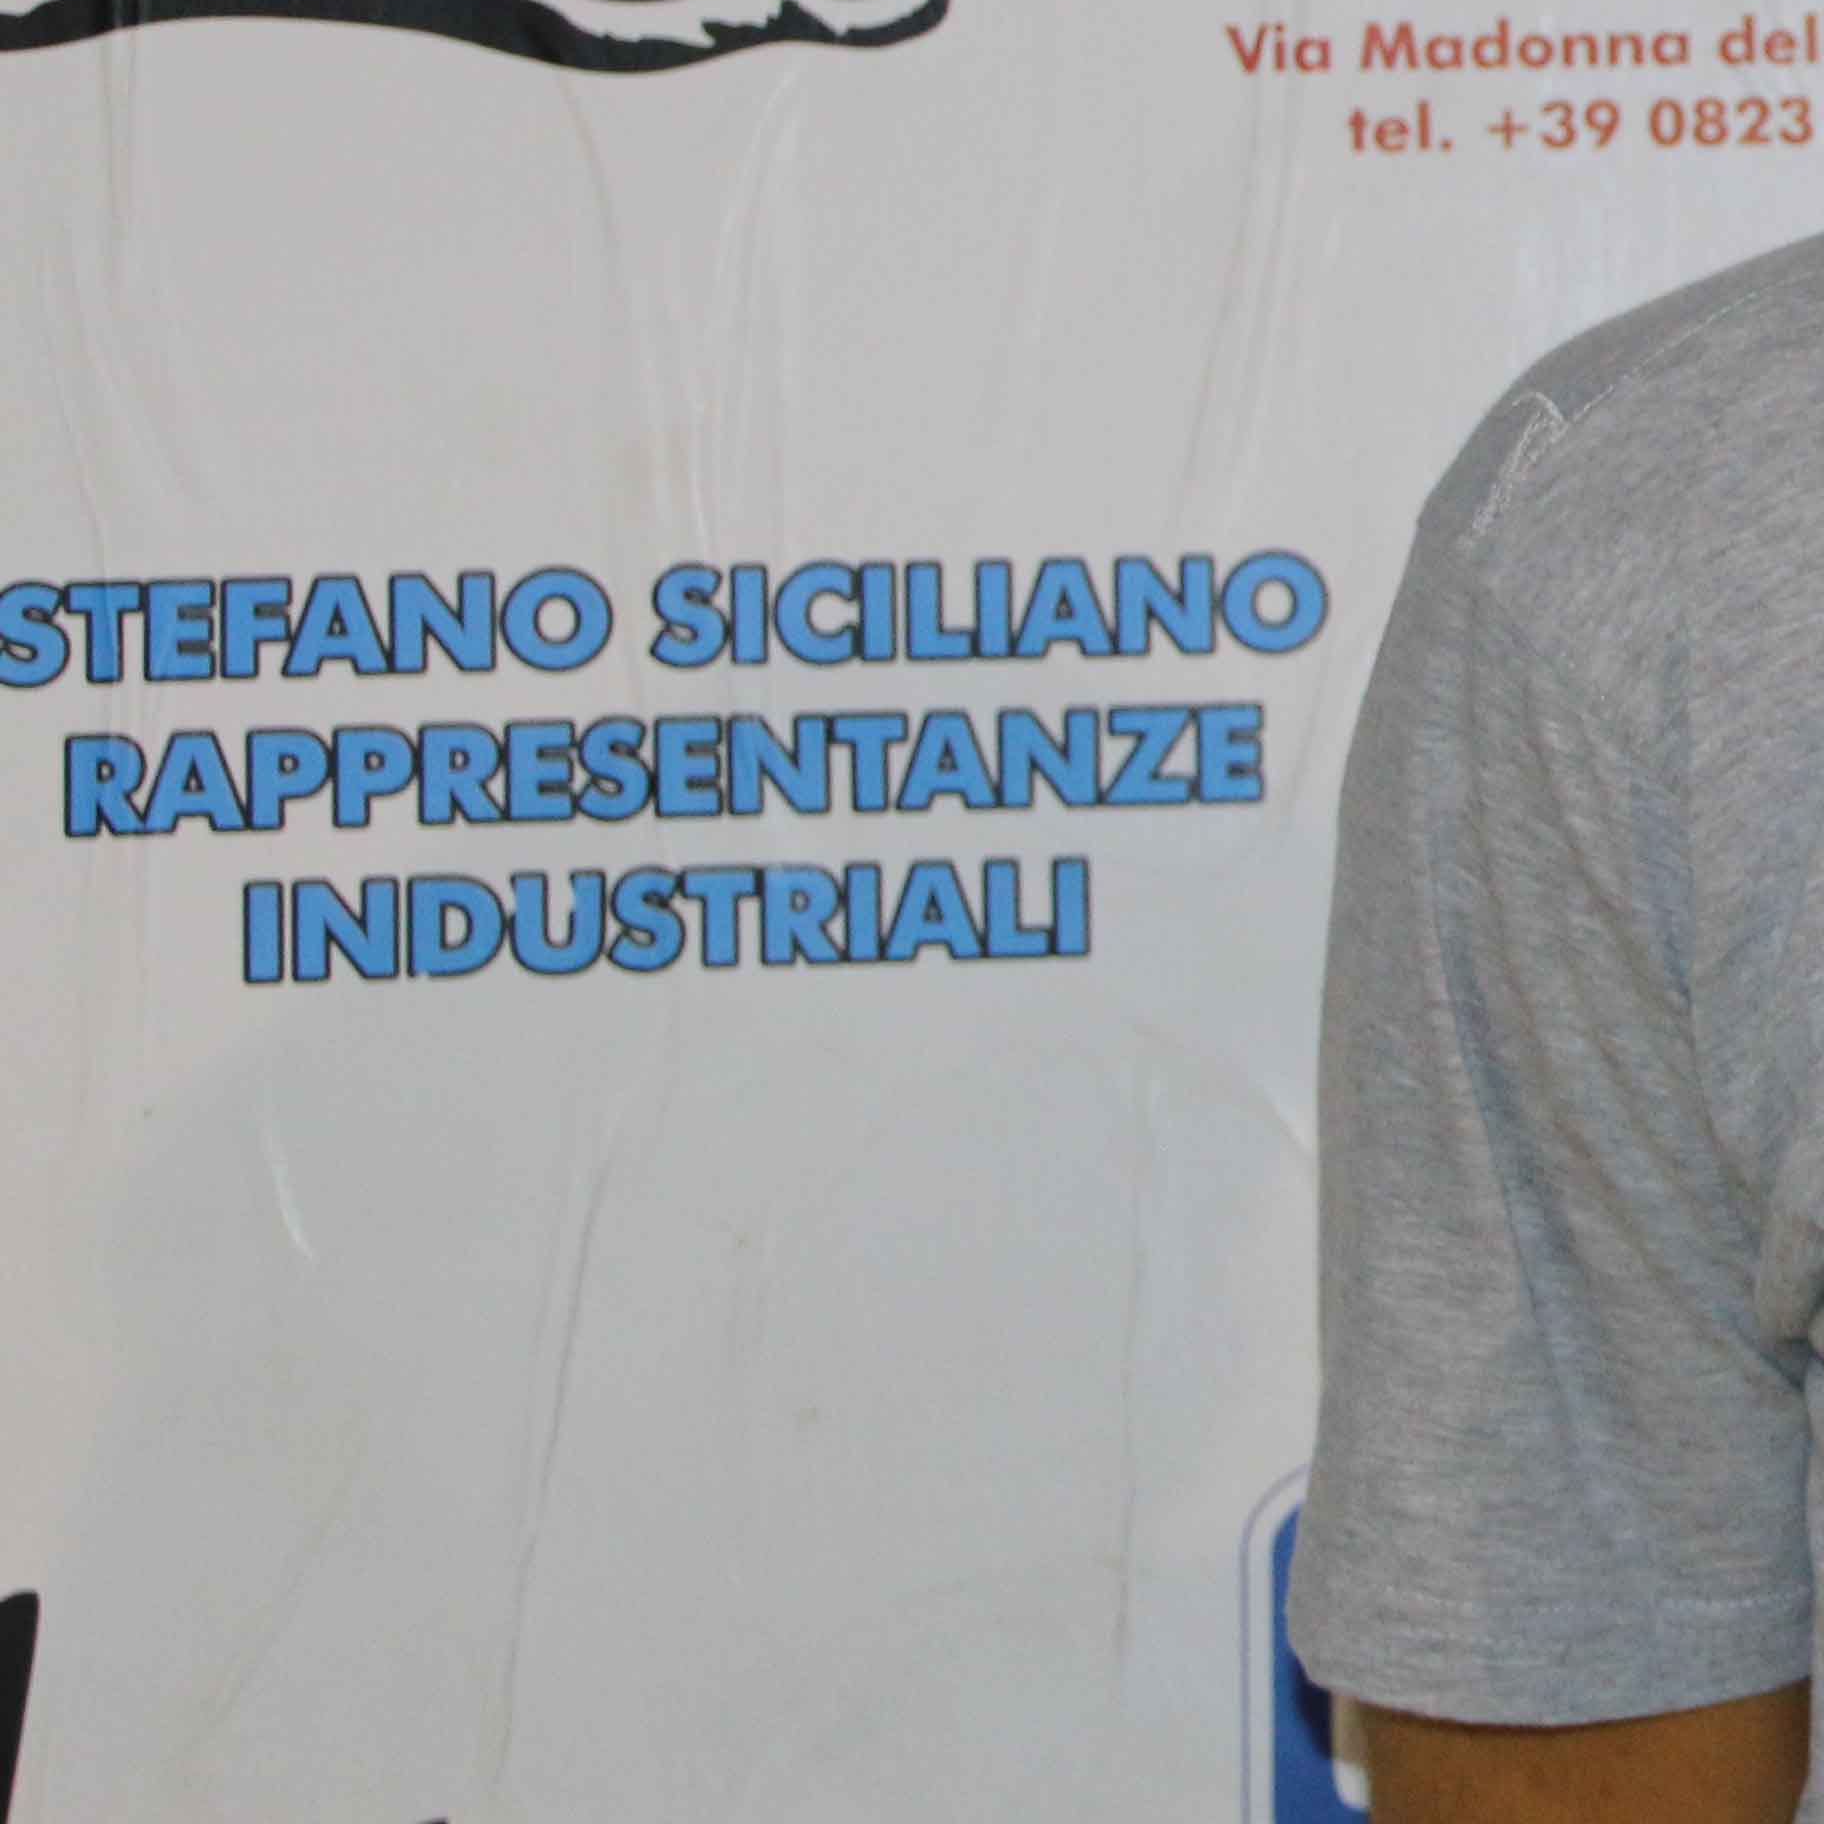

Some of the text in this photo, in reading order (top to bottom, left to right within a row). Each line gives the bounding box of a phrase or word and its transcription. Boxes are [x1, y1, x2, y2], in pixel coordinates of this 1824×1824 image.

[1225, 23, 1332, 74] Via
[1360, 18, 1690, 71] Madonna
[1348, 101, 1453, 153] tel.
[1486, 100, 1620, 150] +39
[1648, 97, 1814, 147] 0823
[0, 550, 1330, 688] STEFANO SICILIANO
[63, 702, 1267, 837] RAPPRESENTANZE
[242, 857, 1090, 983] INDUSTRIALI
